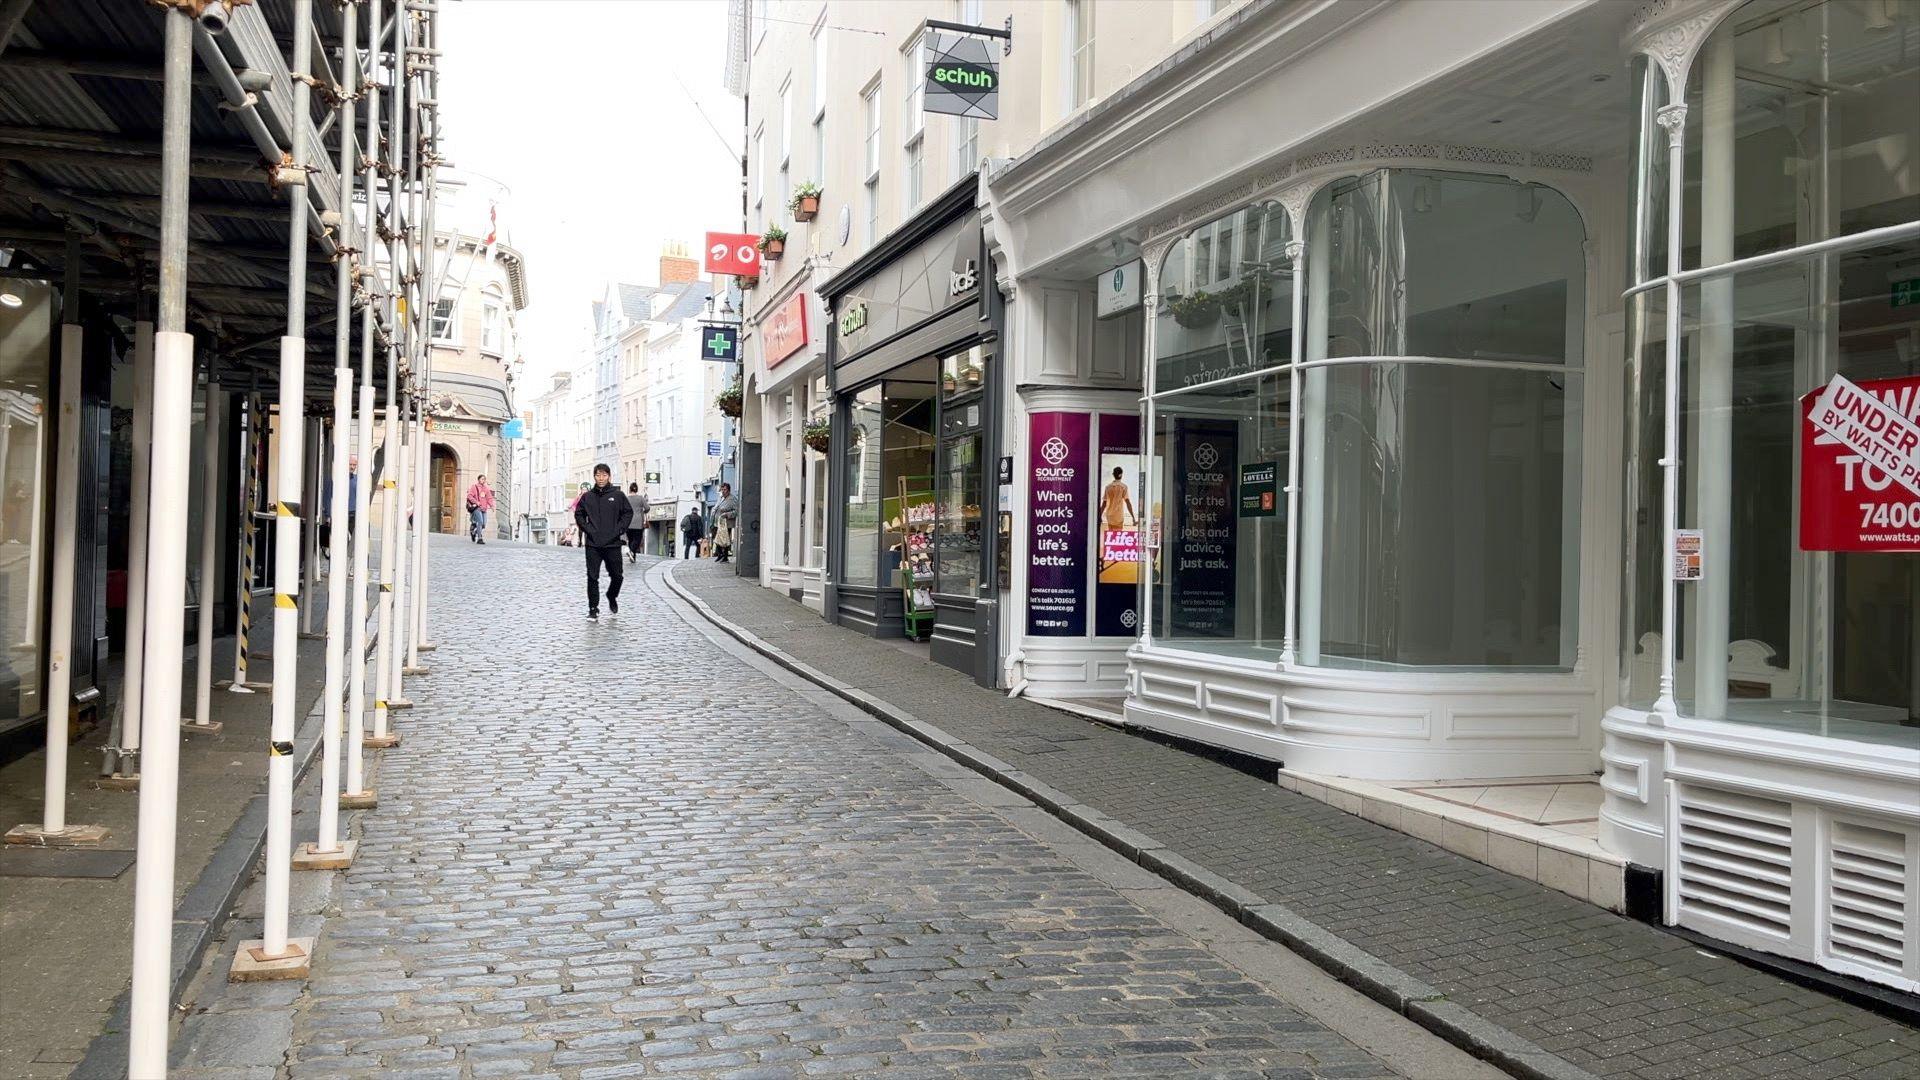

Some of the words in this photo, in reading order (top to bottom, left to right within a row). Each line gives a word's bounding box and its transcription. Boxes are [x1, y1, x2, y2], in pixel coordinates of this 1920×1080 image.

[935, 67, 992, 88] schuh
[840, 303, 866, 336] schuh
[444, 423, 464, 431] BANK
[1833, 385, 1919, 458] UNDER
[1822, 409, 1846, 431] BY
[1846, 424, 1901, 471] WATTS
[1035, 467, 1075, 477] source
[1187, 471, 1224, 482] source
[1243, 473, 1274, 482] LOVELLS
[1836, 454, 1894, 492] TO
[1036, 490, 1073, 502] When
[1184, 494, 1203, 506] For
[1206, 494, 1225, 507] the
[1035, 506, 1074, 518] work's
[1192, 510, 1217, 522] best
[1859, 501, 1920, 529] 7400
[1036, 522, 1071, 536] good,
[1180, 525, 1206, 540] jobs
[1207, 526, 1229, 538] and
[1038, 538, 1069, 551] life's
[1184, 542, 1225, 555] advice,
[1032, 553, 1075, 566] better.
[1179, 557, 1203, 571] just
[1205, 558, 1229, 570] ask.
[1031, 604, 1074, 612] www.source.gg
